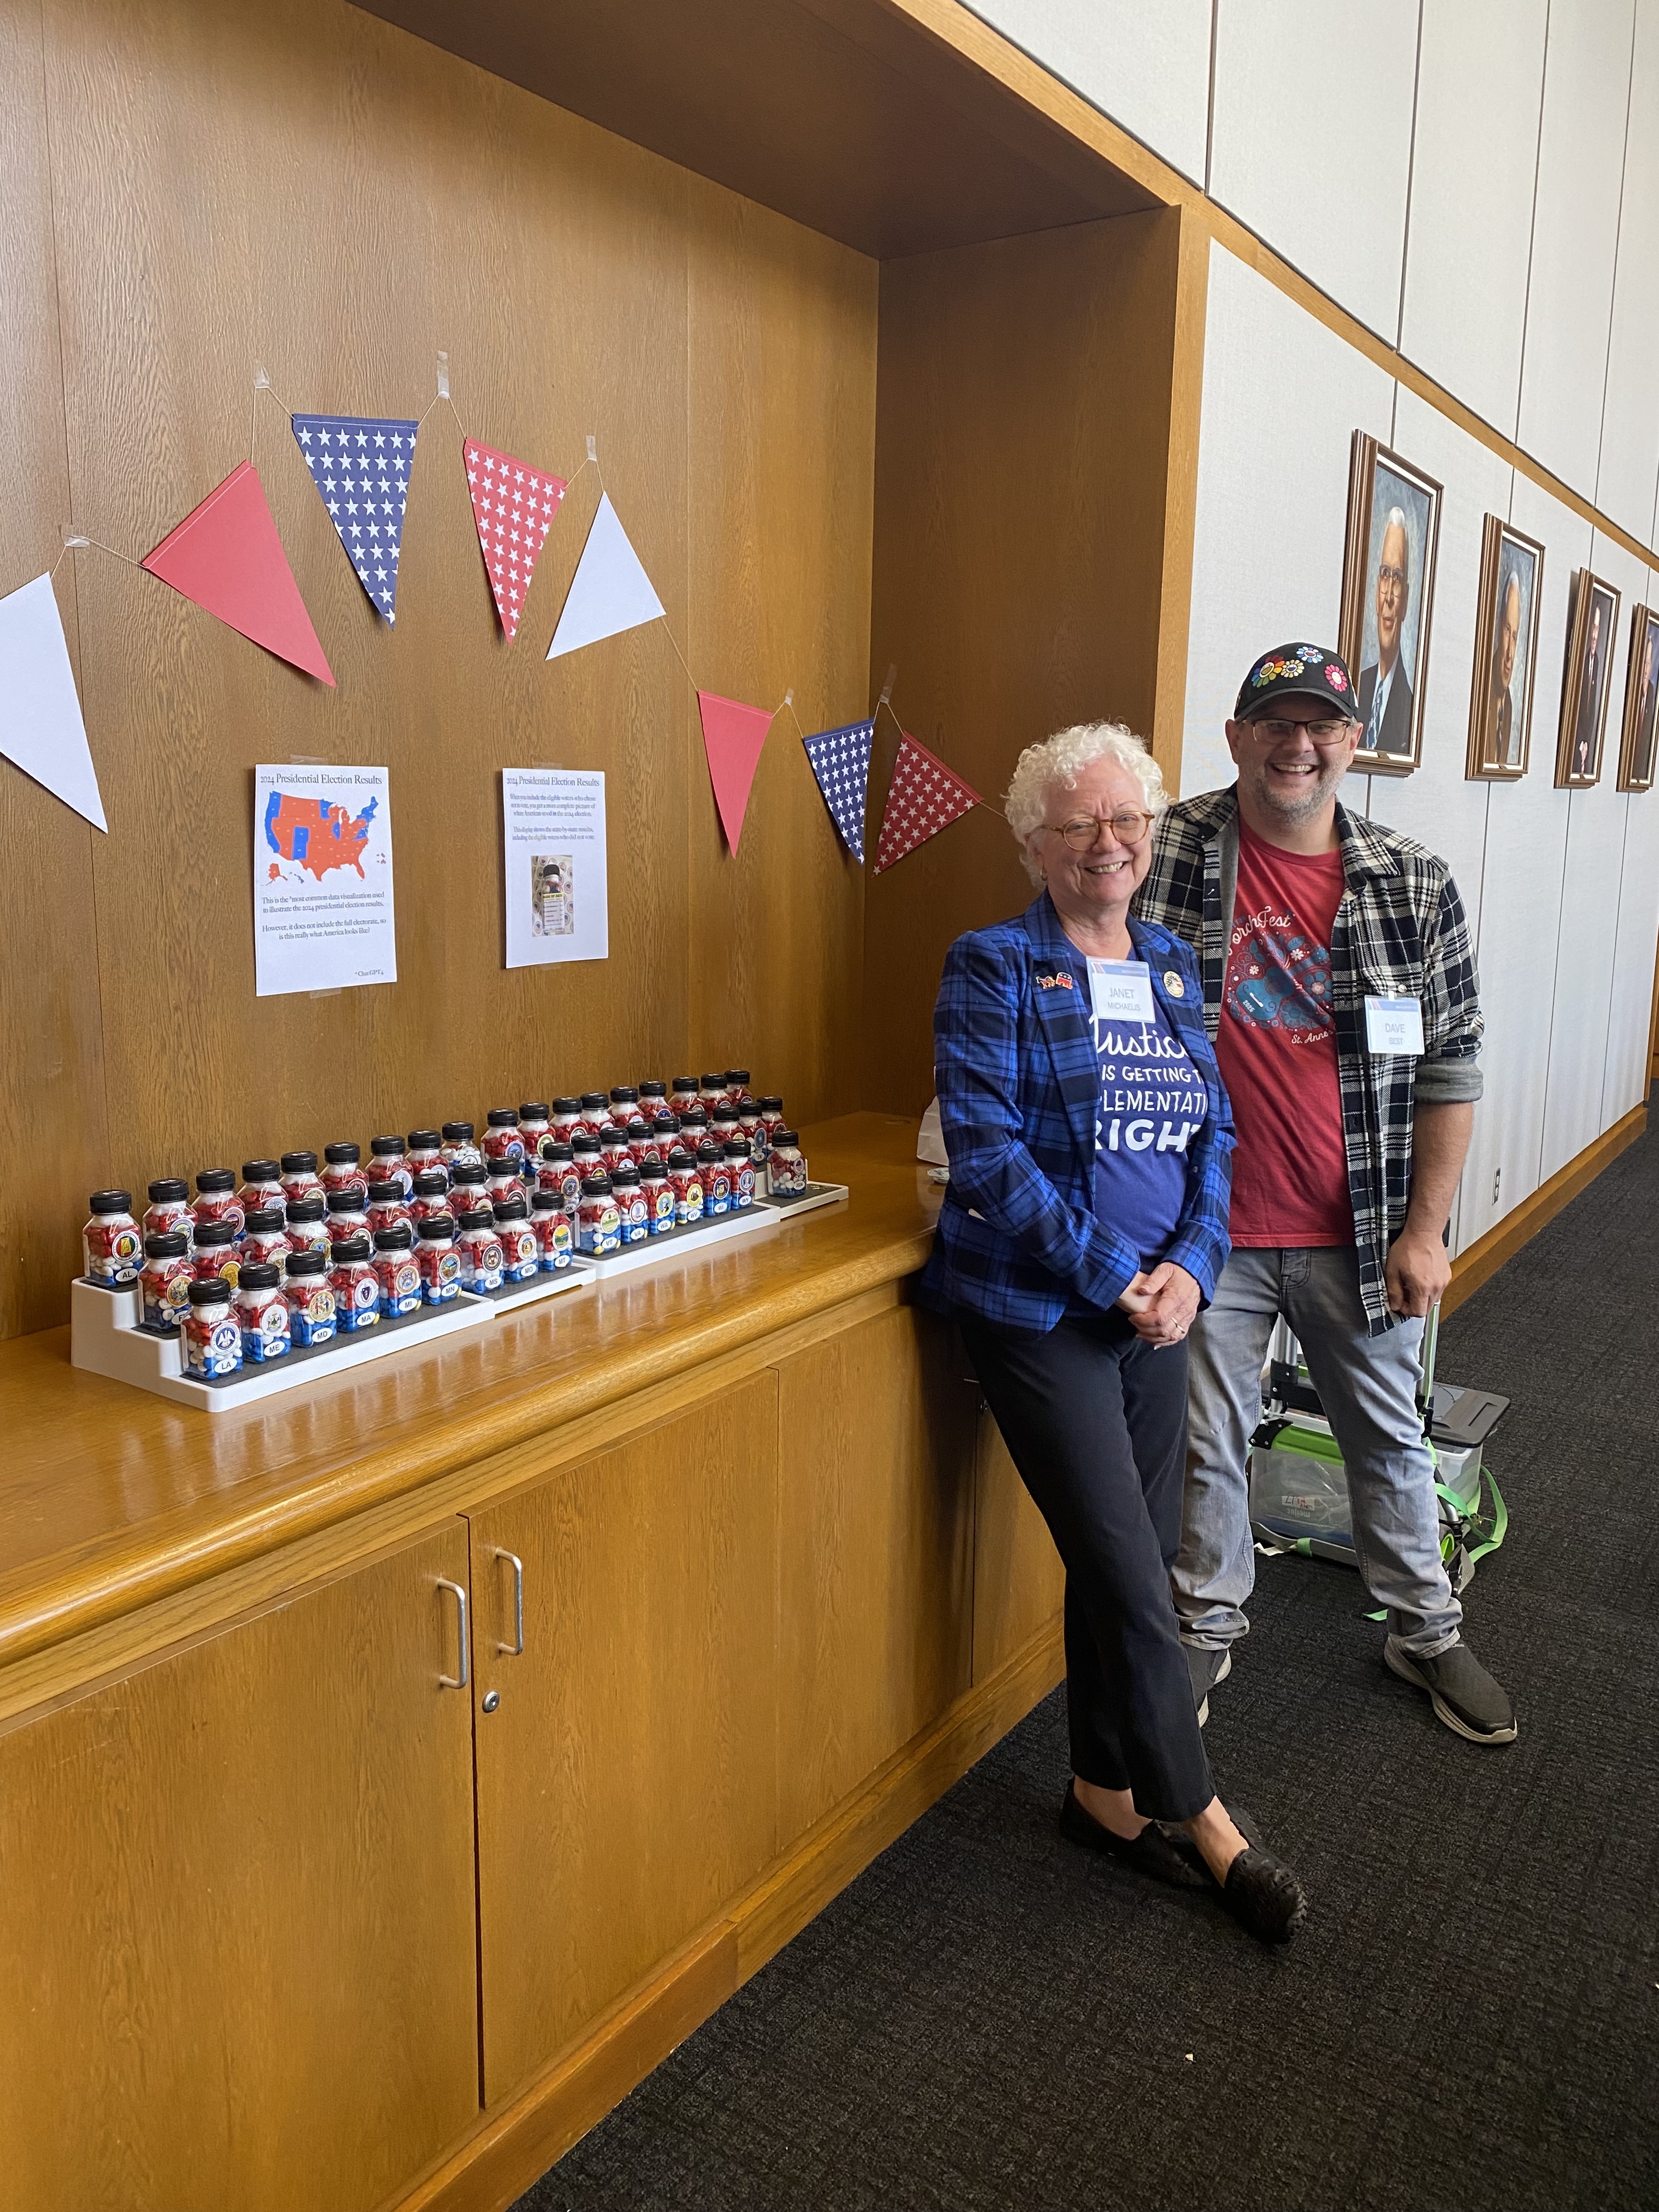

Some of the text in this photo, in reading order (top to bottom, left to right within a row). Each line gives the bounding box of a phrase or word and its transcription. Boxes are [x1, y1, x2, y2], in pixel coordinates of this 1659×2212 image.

[260, 774, 382, 785] 2024 Presidential Election Results
[507, 776, 600, 786] 2024 Presidential Election Results
[315, 902, 345, 912] presidential
[1232, 905, 1291, 945] orchFest
[1109, 987, 1135, 998] JANET
[1107, 1002, 1141, 1011] MICHAELIS
[1385, 1023, 1406, 1033] DAVE
[1291, 1034, 1302, 1044] St.
[1102, 1064, 1116, 1081] IS
[1122, 1066, 1192, 1083] GETTING
[122, 1271, 132, 1279] AL
[445, 1286, 455, 1294] MN
[179, 1313, 185, 1322] F
[317, 1330, 328, 1340] MD
[269, 1344, 280, 1353] ME
[222, 1361, 232, 1370] LA
